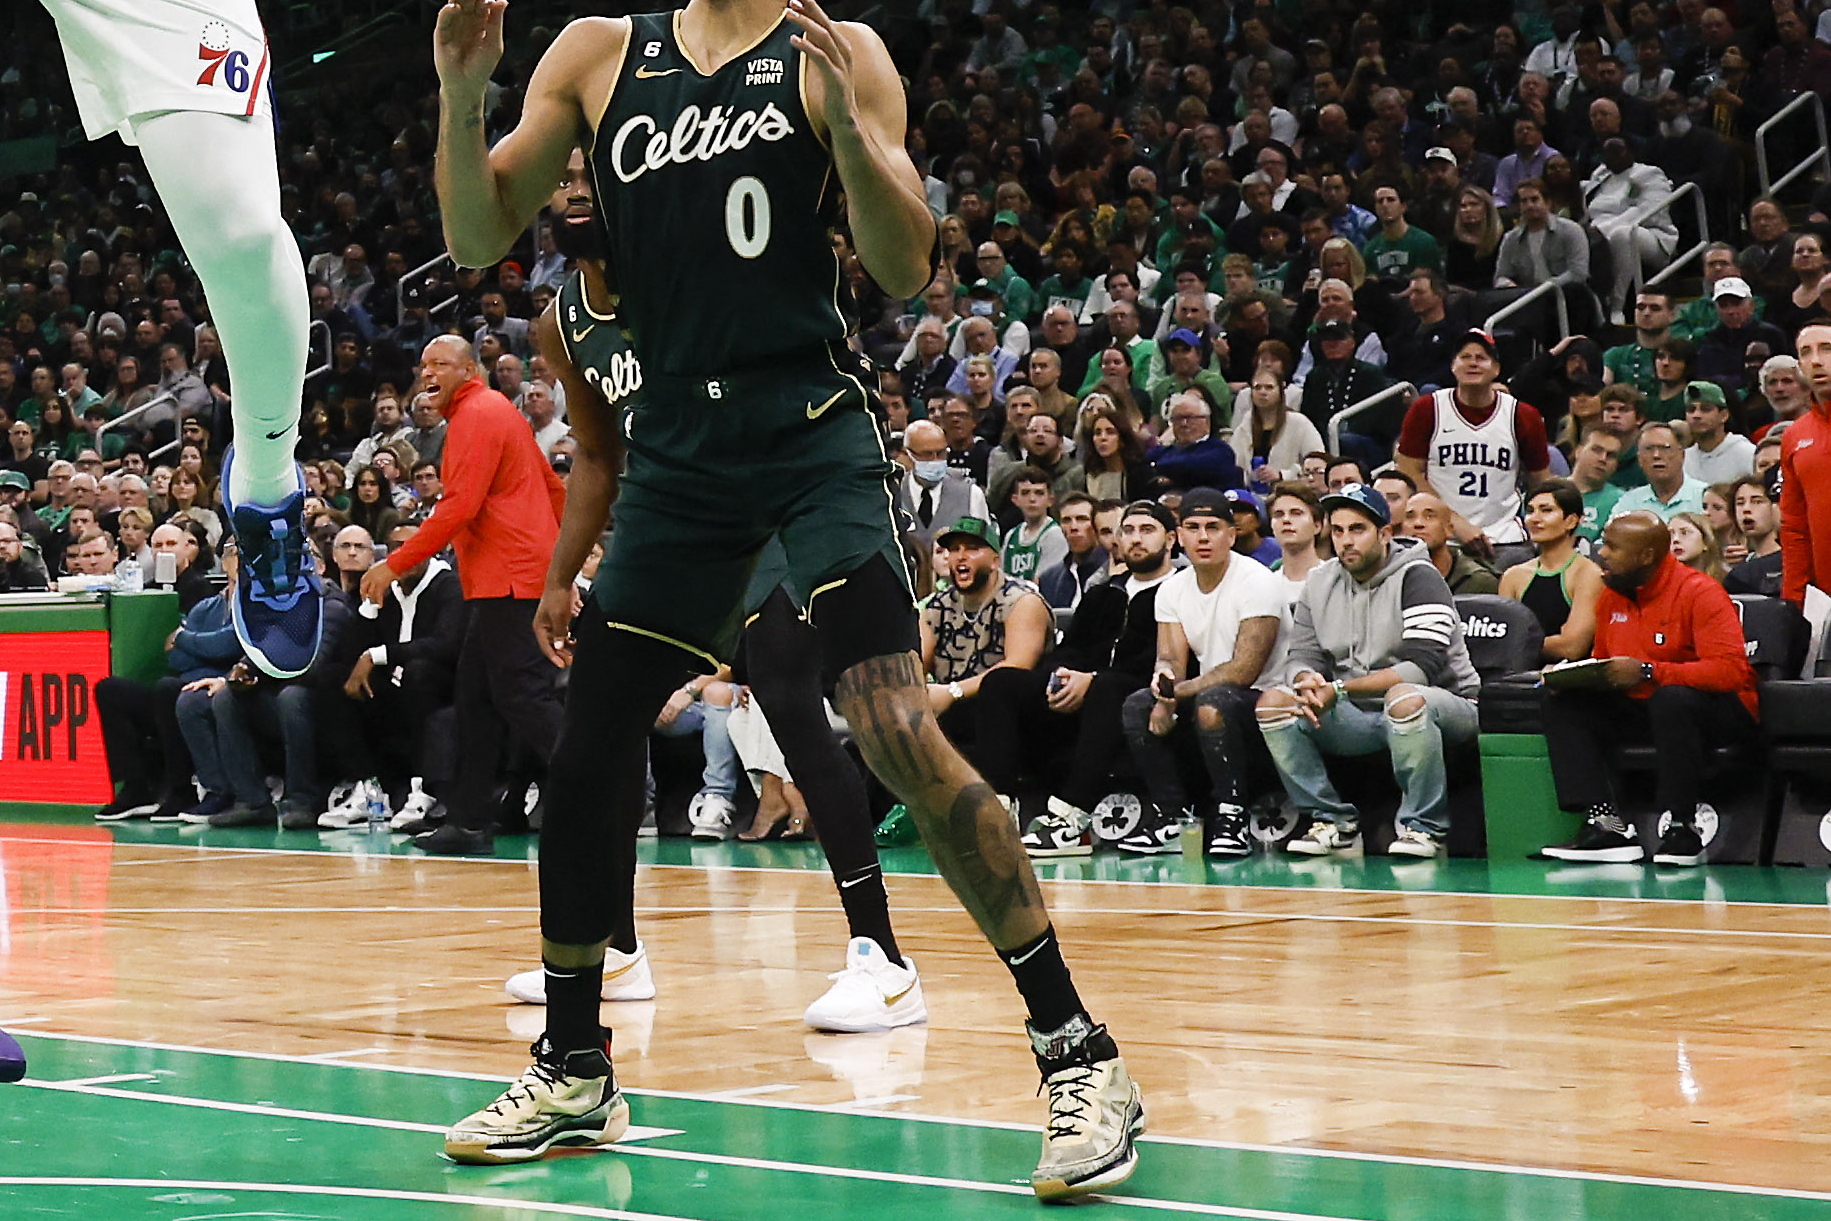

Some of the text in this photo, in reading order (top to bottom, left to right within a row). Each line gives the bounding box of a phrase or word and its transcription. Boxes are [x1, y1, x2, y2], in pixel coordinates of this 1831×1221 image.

[643, 41, 662, 58] 6
[196, 42, 250, 93] 76
[747, 58, 784, 74] VISTA
[745, 72, 784, 87] PRINT
[611, 101, 795, 184] Celtics
[724, 175, 772, 259] 0
[569, 305, 577, 323] 6
[707, 381, 722, 400] 6
[1438, 443, 1511, 471] PHILA
[1458, 471, 1489, 498] 21
[1461, 614, 1508, 639] eltics
[17, 672, 89, 762] APP
